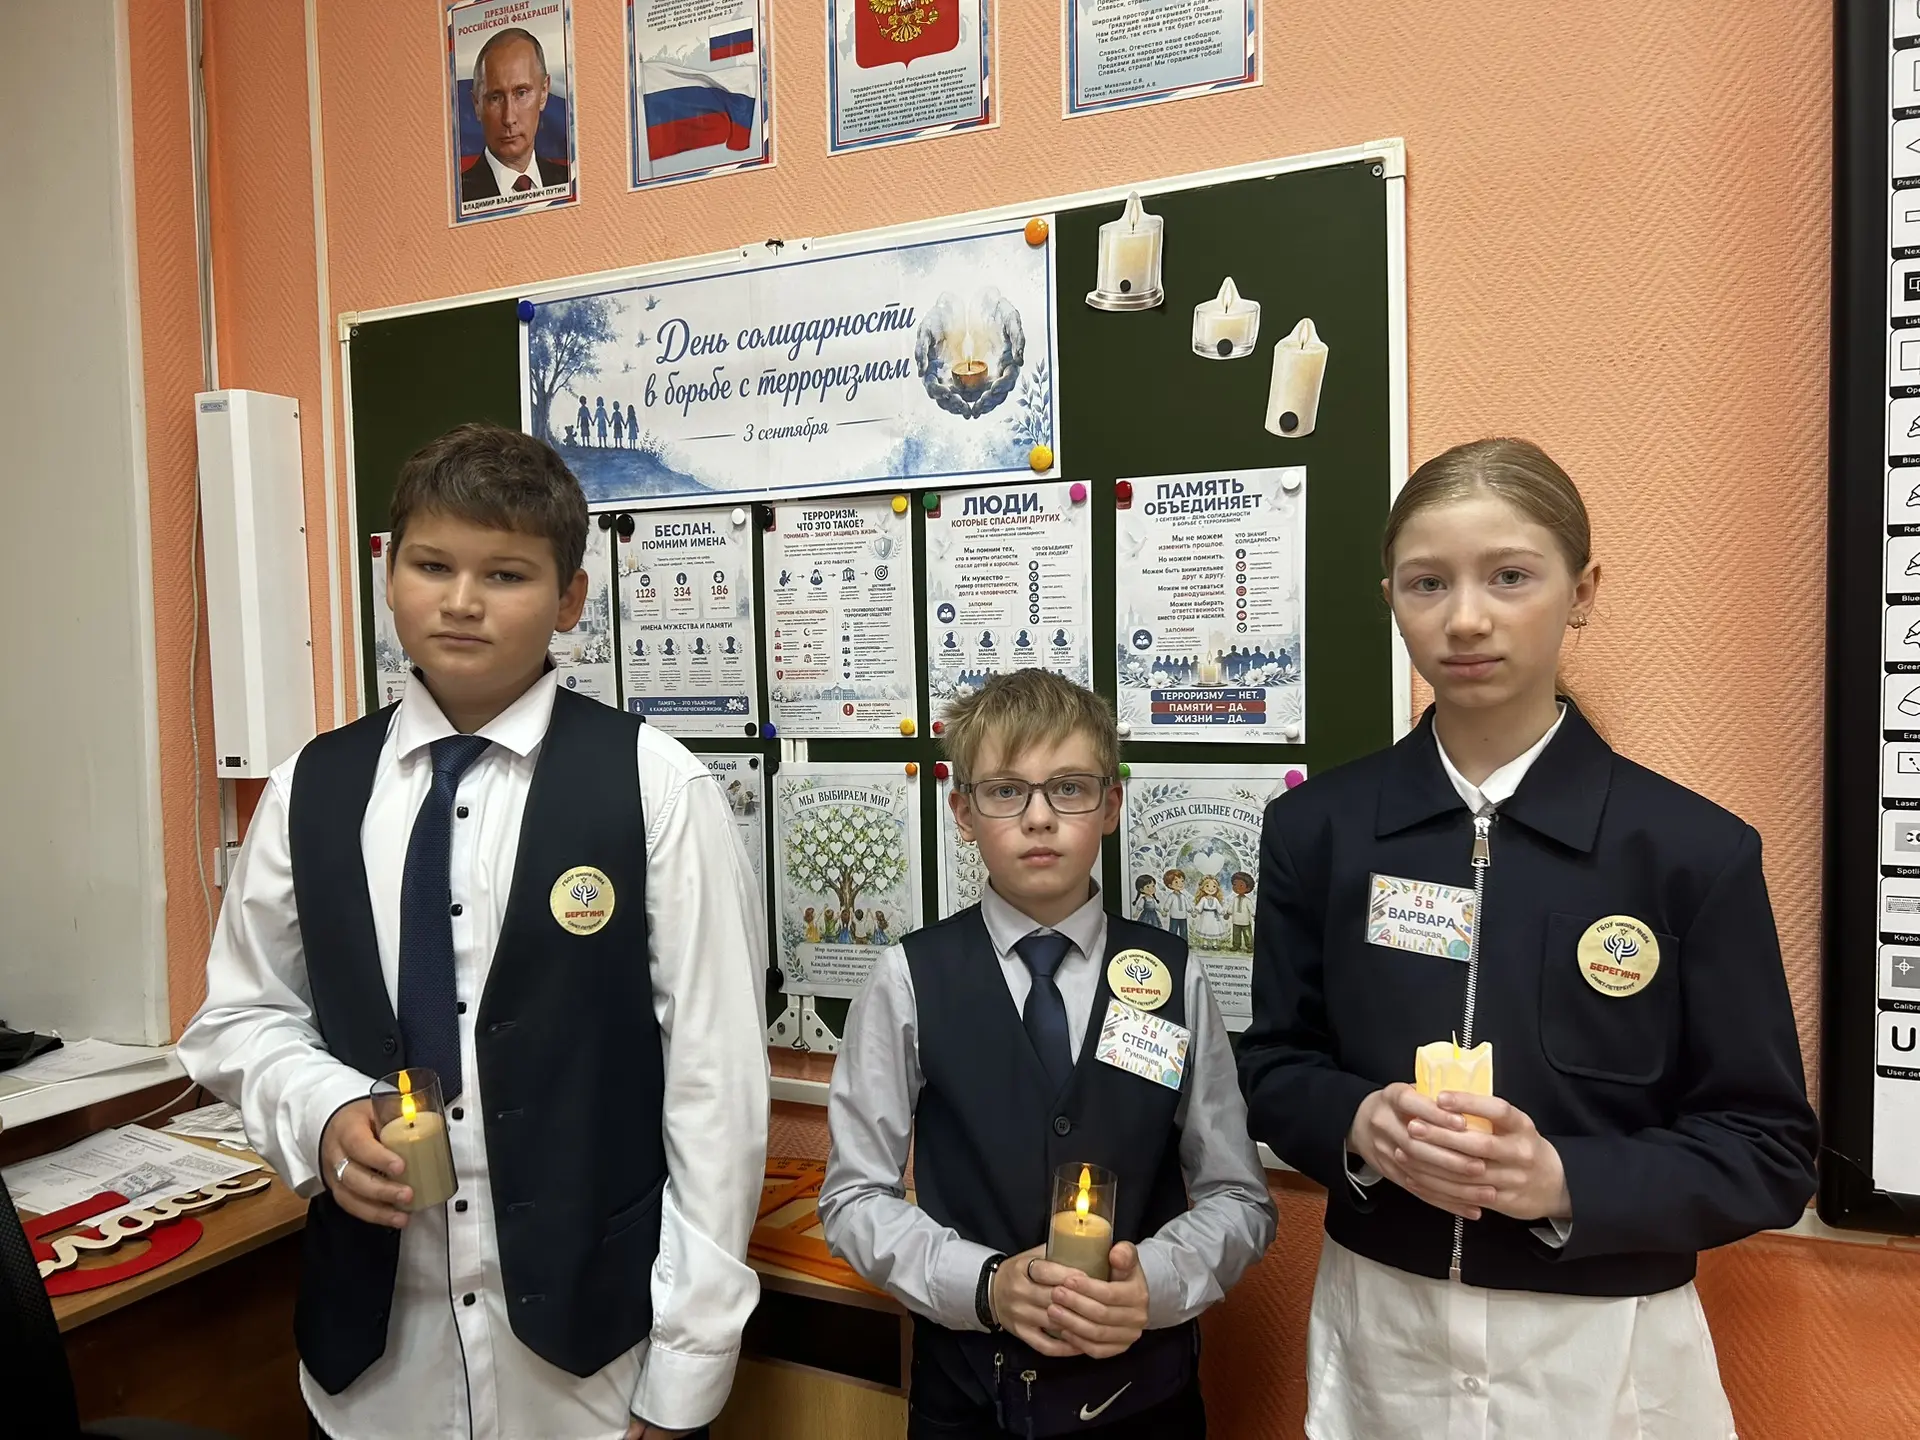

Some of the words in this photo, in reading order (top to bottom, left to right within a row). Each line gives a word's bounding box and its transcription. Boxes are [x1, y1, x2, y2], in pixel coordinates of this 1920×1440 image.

[485, 1, 530, 19] ПРЕЗИДЕНТ
[458, 16, 509, 35] РОССИЙСКОЙ
[511, 4, 559, 22] ФЕДЕРАЦИИ
[1108, 20, 1139, 29] Грядущие
[1156, 9, 1191, 20] открывают
[1178, 21, 1196, 30] будет
[1198, 15, 1223, 25] всегда!
[1129, 41, 1163, 52] Отечество
[1184, 29, 1221, 41] свободное,
[1098, 61, 1129, 70] Предками
[1132, 56, 1154, 64] данная
[1156, 50, 1187, 61] мудрость
[1189, 42, 1222, 53] народная!
[1106, 53, 1135, 62] Братских
[1137, 47, 1164, 56] народов
[1185, 38, 1214, 47] вековой,
[1128, 62, 1153, 70] страна!
[1167, 54, 1199, 64] гордимся
[1201, 49, 1222, 58] тобой!
[463, 200, 495, 210] ВЛАДИМИР
[496, 192, 544, 204] ВЛАДИМИРОВИЧ
[546, 186, 566, 195] ПУТИН
[656, 318, 729, 364] День
[737, 302, 916, 361] солидарности
[644, 373, 658, 407] в
[665, 366, 732, 417] борьбе
[740, 378, 750, 397] с
[758, 358, 910, 407] терроризмом
[743, 424, 754, 442] 3
[758, 417, 829, 442] сентября
[1157, 478, 1244, 499] ПАМЯТЬ
[963, 492, 1044, 515] ЛЮДИ,
[1144, 494, 1262, 516] ОБЪЕДИНЯЕТ
[802, 509, 858, 521] ТЕРРОРИЗМ:
[951, 519, 988, 528] КОТОРЫЕ
[990, 516, 1028, 526] СПАСАЛИ
[1030, 514, 1060, 524] ДРУГИХ
[655, 522, 715, 537] БЕСЛАН.
[797, 522, 812, 531] ЧТО
[815, 521, 830, 530] ЭТО
[834, 519, 864, 529] ТАКОЕ?
[642, 538, 688, 550] ПОМНИМ
[691, 536, 726, 547] ИМЕНА
[1192, 541, 1224, 549] прошлое.
[635, 589, 656, 598] 1128
[674, 587, 691, 596] 334
[711, 586, 728, 595] 186
[1161, 692, 1224, 700] ТЕРРОРИЗМУ
[1239, 691, 1260, 699] НЕТ.
[1169, 703, 1213, 712] ПАМЯТИ
[1228, 703, 1247, 712] ДА.
[1175, 714, 1213, 723] ЖИЗНИ
[1228, 714, 1246, 723] ДА.
[708, 761, 737, 771] общей
[798, 794, 814, 807] МЫ
[818, 790, 867, 802] ВЫБИРАЕМ
[870, 794, 890, 808] МИР
[1148, 806, 1186, 827] ДРУЖБА
[1188, 804, 1231, 816] СИЛЬНЕЕ
[1233, 808, 1263, 828] СТРАХ
[970, 853, 975, 862] 3
[970, 870, 976, 879] 4
[971, 887, 976, 896] 5
[1415, 896, 1422, 907] 5
[1388, 907, 1456, 929] ВАРВАРА
[1399, 924, 1442, 939] Высоцкая
[1597, 922, 1613, 933] ГБОУ
[1590, 962, 1640, 980] БЕРЕГИНЯ
[1121, 986, 1161, 996] БЕРЕГИНЯ
[1141, 1025, 1148, 1035] 5
[1122, 1032, 1168, 1059] СТЕПАН
[1892, 1026, 1916, 1052] U
[1125, 1048, 1159, 1066] Румянцев
